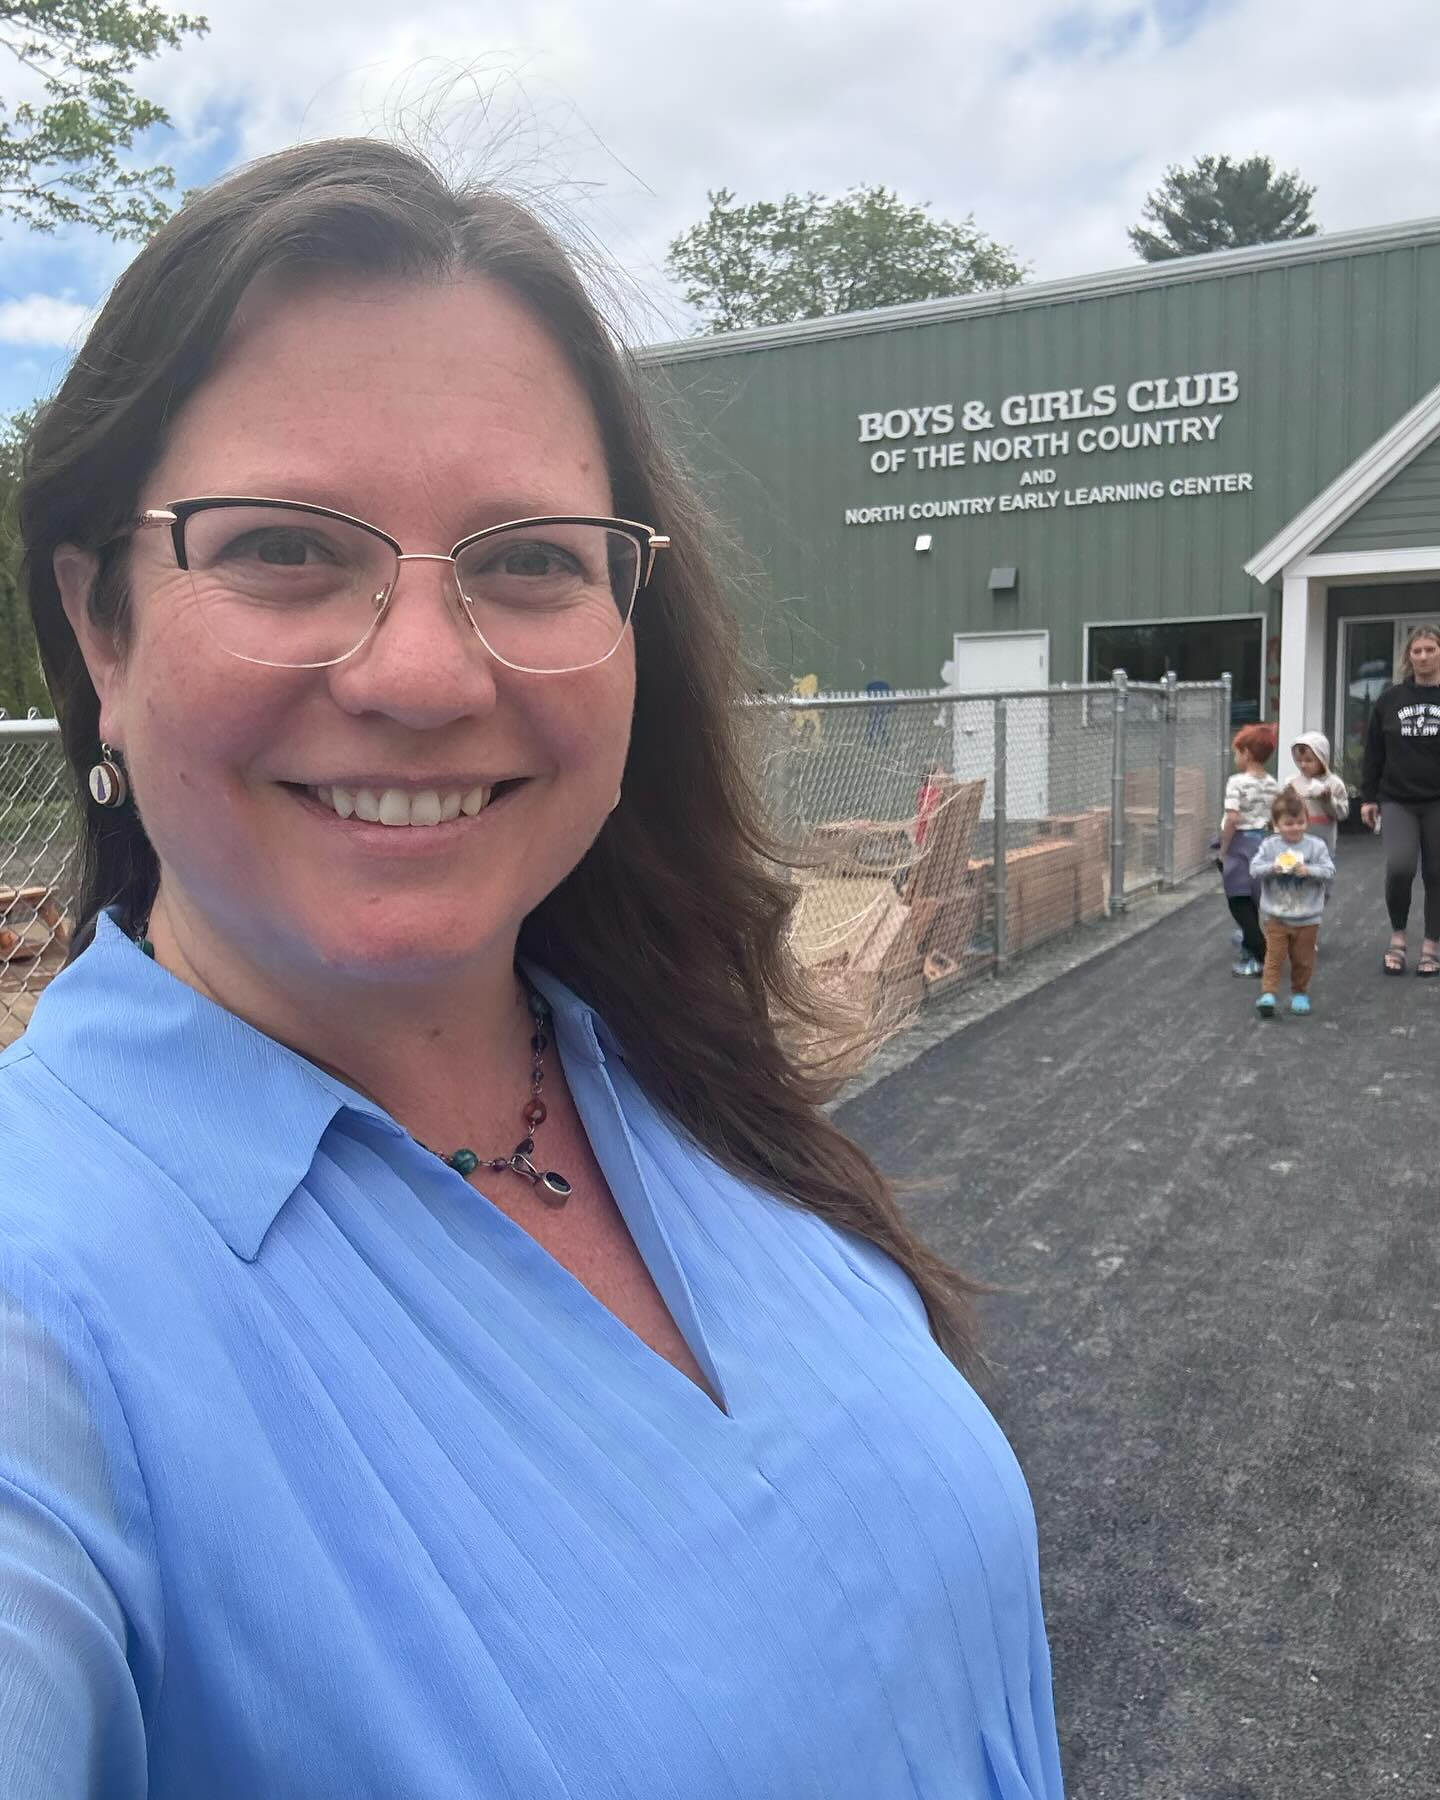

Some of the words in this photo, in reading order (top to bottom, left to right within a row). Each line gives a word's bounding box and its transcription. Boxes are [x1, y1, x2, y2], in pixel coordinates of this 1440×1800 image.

[858, 403, 955, 443] BOYS
[961, 400, 995, 432] &
[1000, 384, 1118, 426] GIRLS
[1127, 370, 1240, 412] CLUB
[870, 448, 907, 473] OF
[913, 443, 966, 470] THE
[973, 431, 1069, 464] NORTH
[1077, 414, 1223, 452] COUNTRY
[845, 506, 905, 525] NORTH
[908, 496, 995, 520] COUNTRY
[999, 491, 1060, 512] EARLY
[1064, 481, 1164, 507] LEARNING
[1169, 473, 1253, 497] CENTER
[1019, 469, 1056, 486] AND
